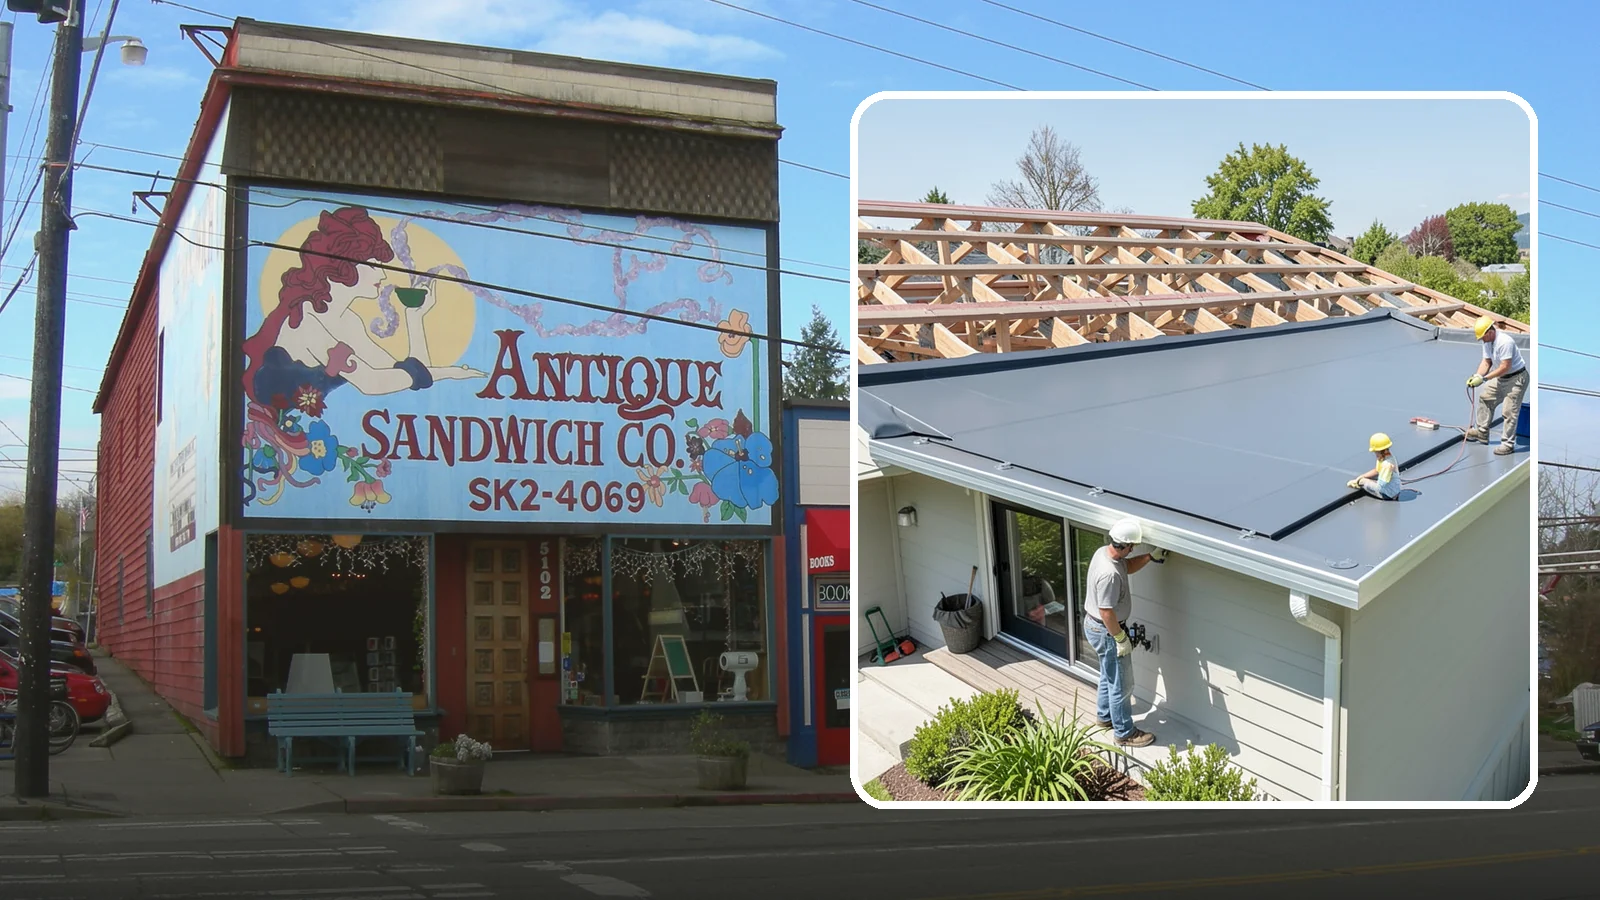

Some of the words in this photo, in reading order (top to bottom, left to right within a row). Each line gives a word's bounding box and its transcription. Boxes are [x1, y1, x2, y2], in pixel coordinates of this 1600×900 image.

[476, 329, 723, 420] ANTIQUE
[361, 408, 604, 467] SANDWICH
[617, 422, 685, 468] CO.
[468, 477, 645, 512] SK2-4069
[540, 542, 551, 600] 5102
[809, 555, 834, 569] BOOKS
